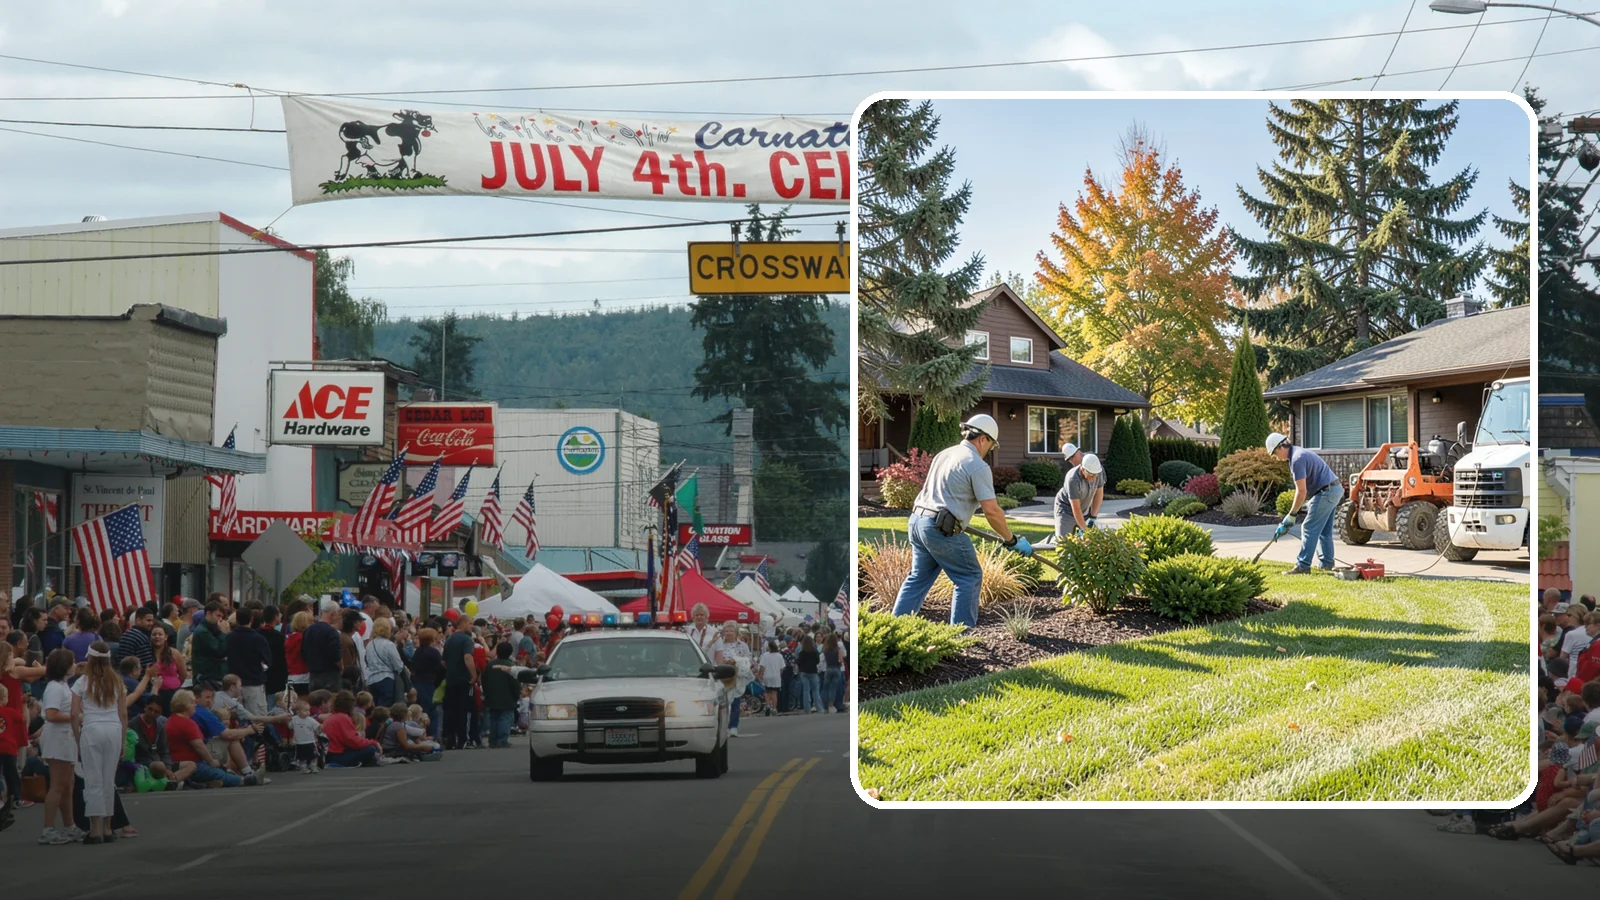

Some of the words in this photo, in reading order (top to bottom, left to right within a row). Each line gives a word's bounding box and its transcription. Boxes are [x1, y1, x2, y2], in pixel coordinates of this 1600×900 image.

[481, 141, 605, 193] JULY
[632, 150, 746, 197] 4th.
[697, 253, 850, 280] CROSSWA
[283, 380, 373, 420] ACE
[406, 409, 453, 422] CEDAR
[283, 421, 371, 437] Hardware
[416, 428, 477, 447] Coca-Cola
[354, 467, 384, 480] Simpl
[83, 485, 94, 494] St.
[95, 485, 124, 495] Vincent
[126, 486, 136, 495] de
[137, 486, 155, 495] Paul
[688, 526, 741, 535] CRNATION
[699, 535, 730, 543] GLASS
